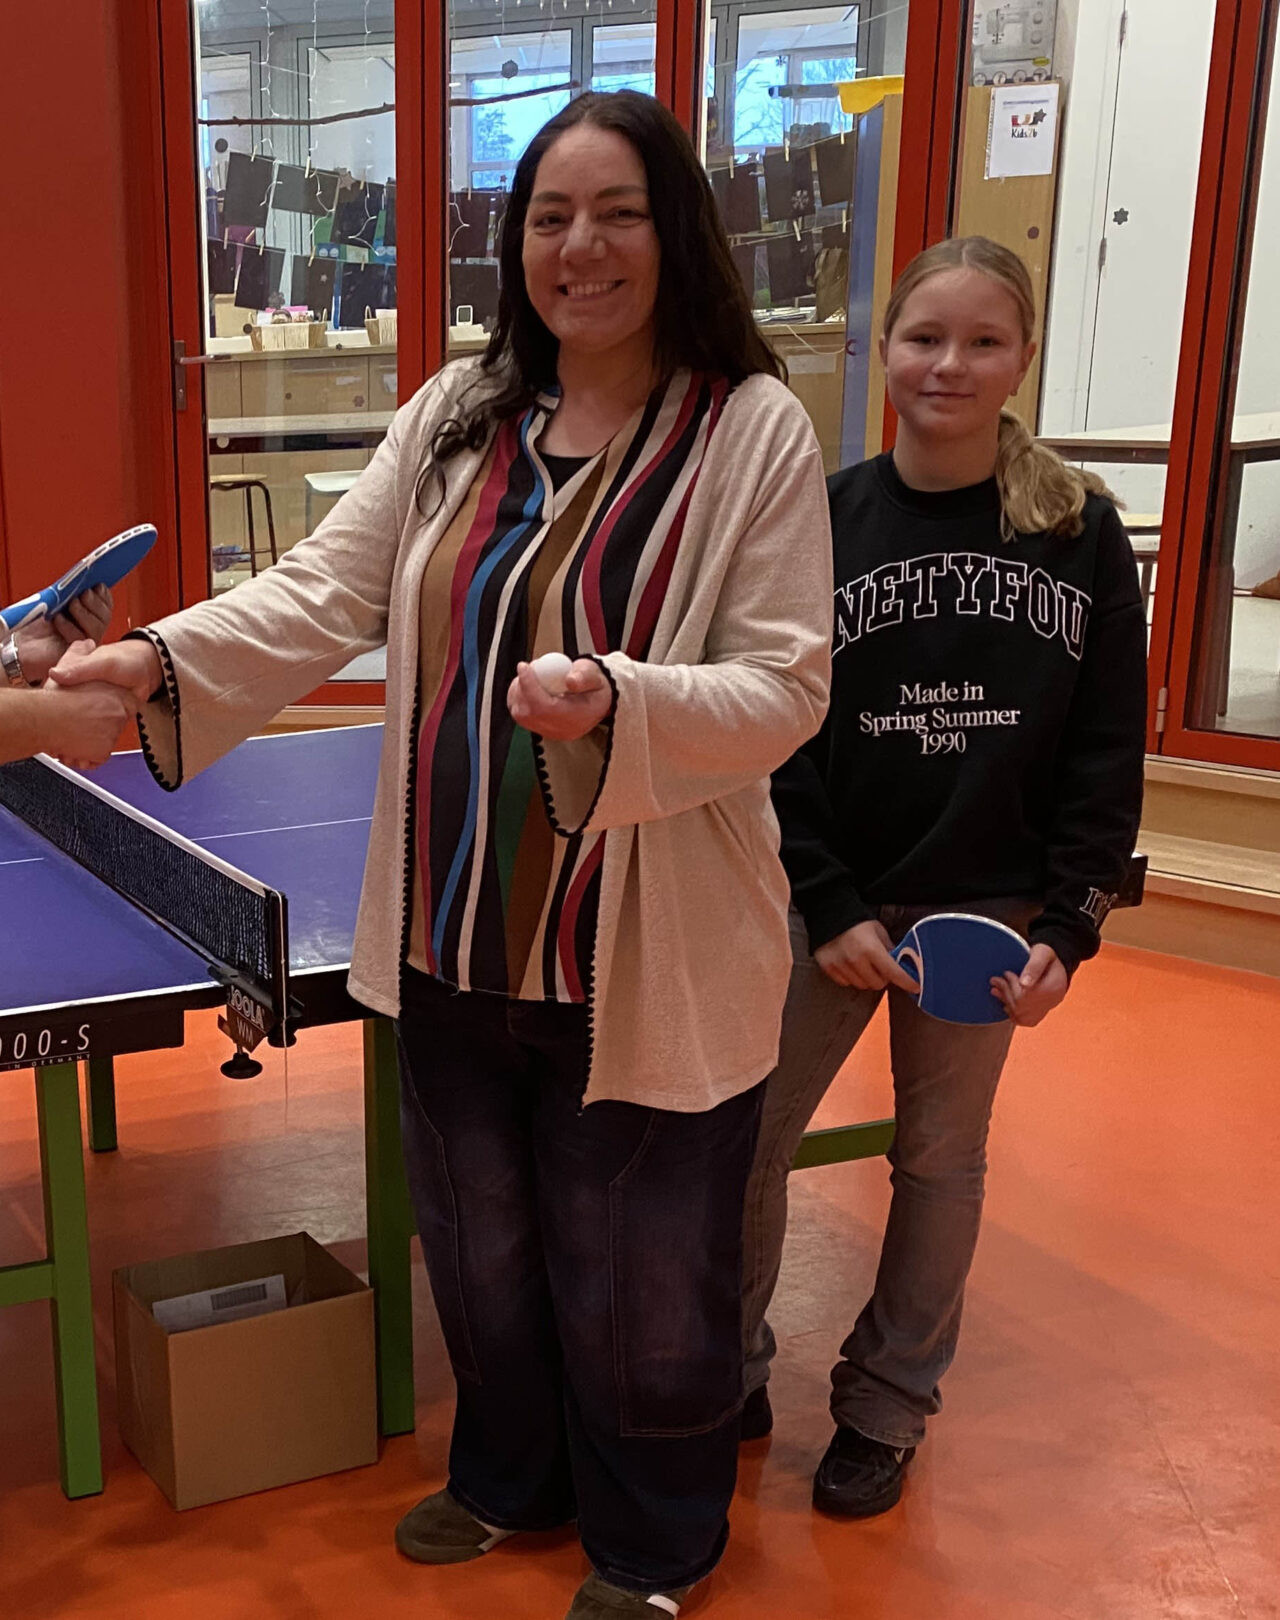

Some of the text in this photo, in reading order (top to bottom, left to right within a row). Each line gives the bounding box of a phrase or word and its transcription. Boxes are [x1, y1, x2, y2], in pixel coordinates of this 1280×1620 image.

[899, 681, 984, 705] Made in
[859, 707, 1021, 737] Spring Summer
[920, 731, 967, 755] 1990
[230, 984, 265, 1030] JOOLA
[236, 1015, 254, 1047] WM
[7, 1063, 21, 1071] IN
[31, 1053, 92, 1068] GERMANY
